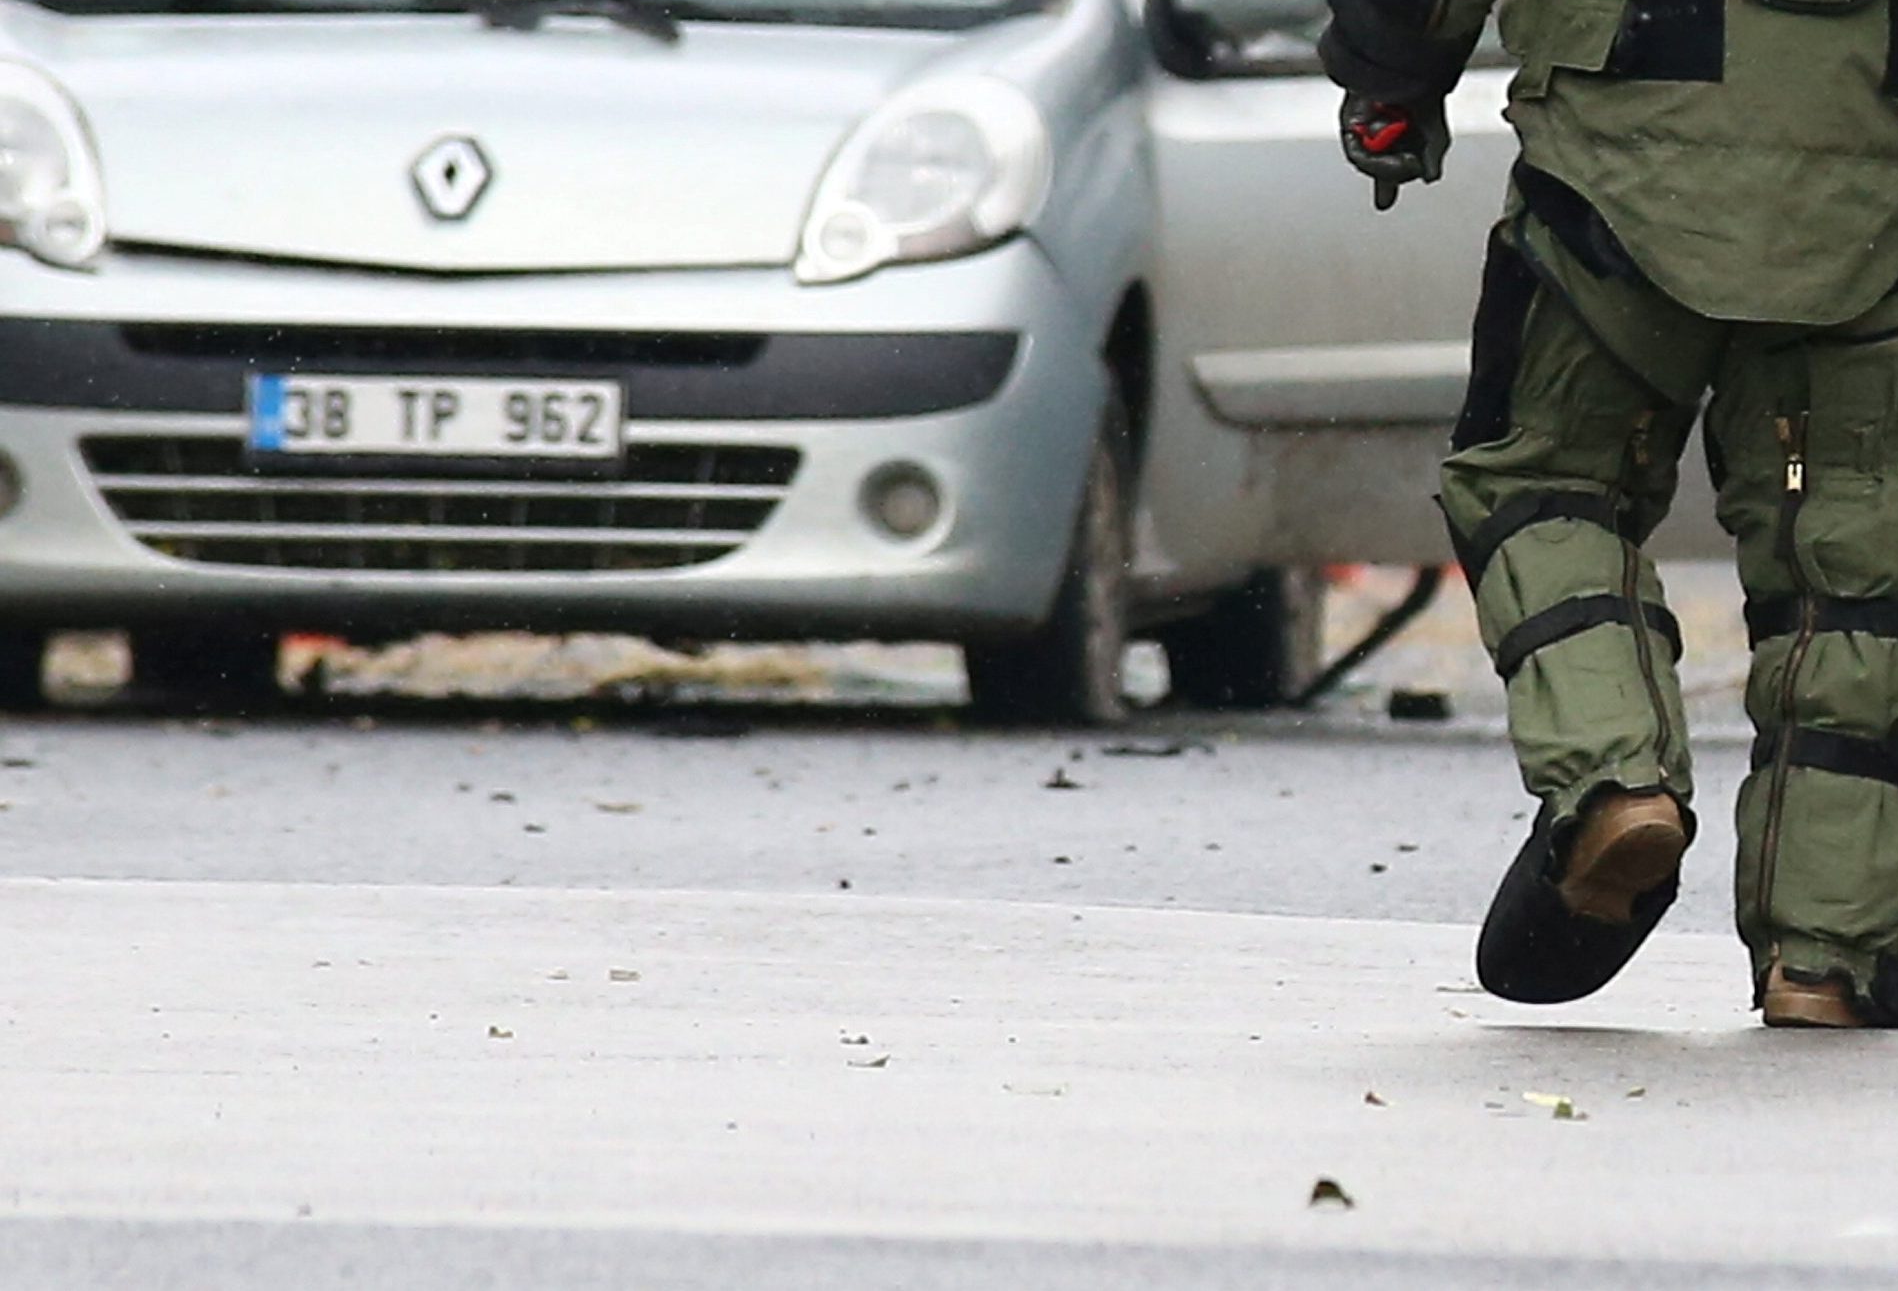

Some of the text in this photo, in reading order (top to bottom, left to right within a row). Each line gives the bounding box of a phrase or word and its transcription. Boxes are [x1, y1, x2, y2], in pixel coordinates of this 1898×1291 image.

[284, 389, 604, 444] 38 TP 962
